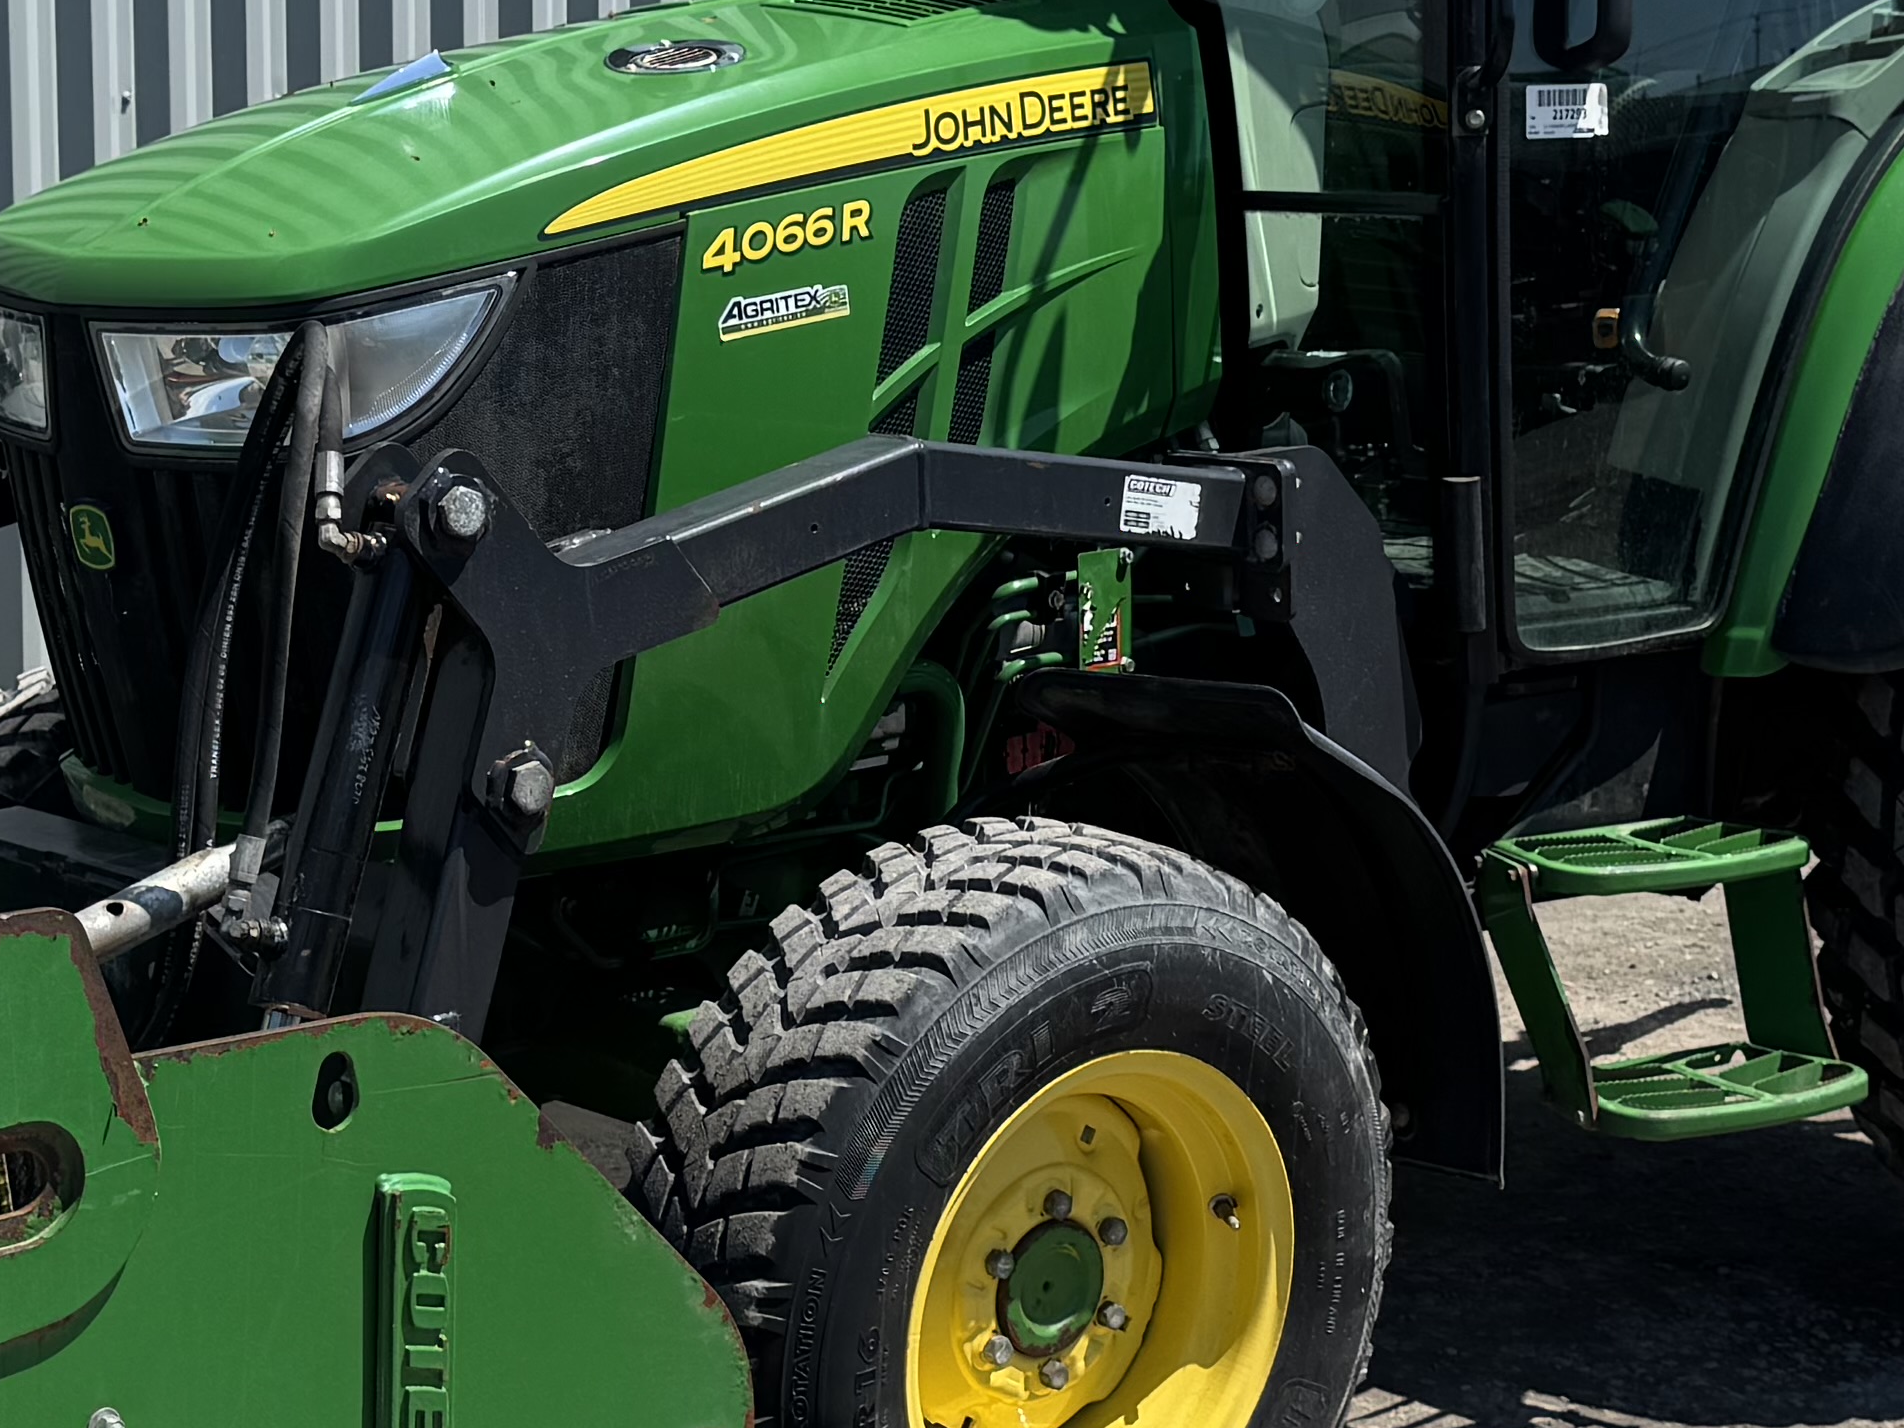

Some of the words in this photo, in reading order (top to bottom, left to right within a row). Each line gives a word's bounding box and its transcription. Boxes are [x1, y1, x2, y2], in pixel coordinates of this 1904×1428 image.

[912, 102, 1015, 150] JOHN
[1020, 84, 1132, 131] DEERE
[721, 288, 822, 325] AGRITEX
[1129, 480, 1171, 494] COTECH
[1200, 992, 1298, 1073] STEEL
